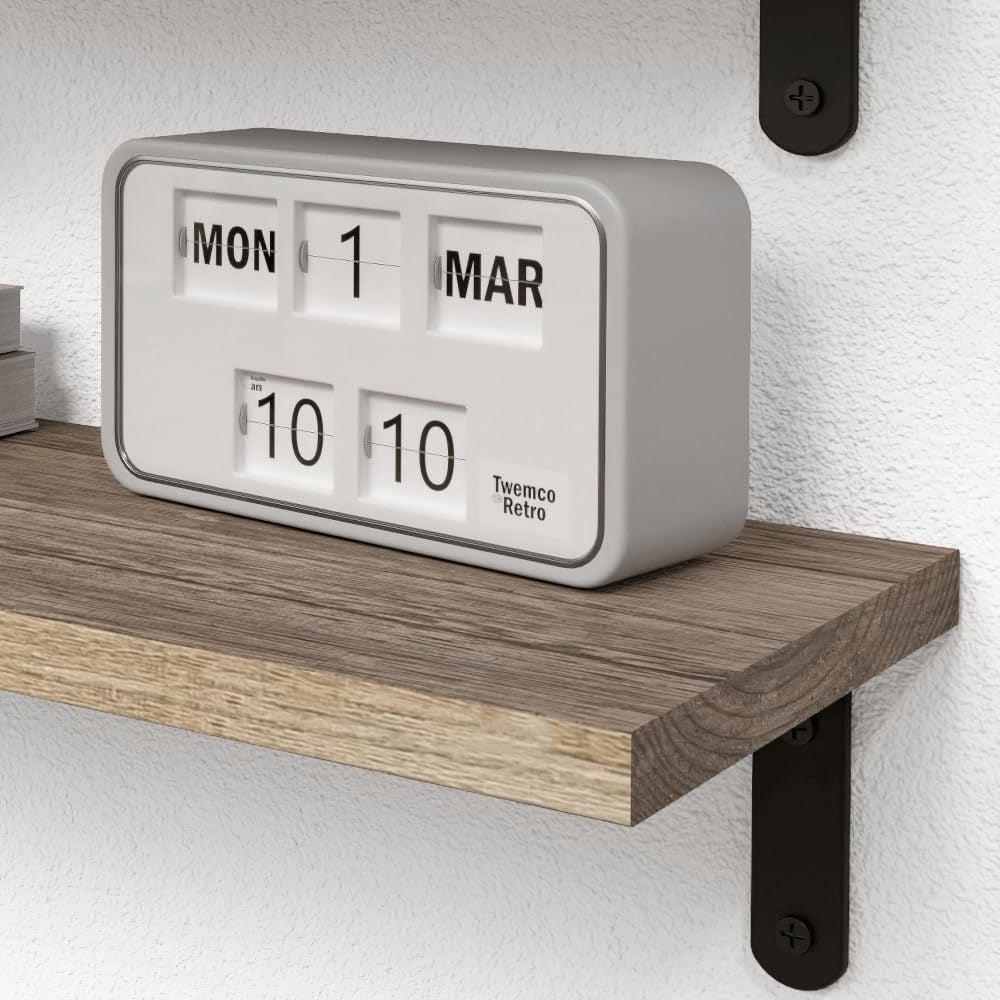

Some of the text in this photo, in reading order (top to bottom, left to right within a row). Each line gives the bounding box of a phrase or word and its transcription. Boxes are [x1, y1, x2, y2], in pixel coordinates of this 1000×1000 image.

[193, 221, 544, 309] MON 1 MAR
[257, 391, 455, 492] 10 10
[492, 474, 557, 504] Twemco
[503, 496, 547, 521] Retro
